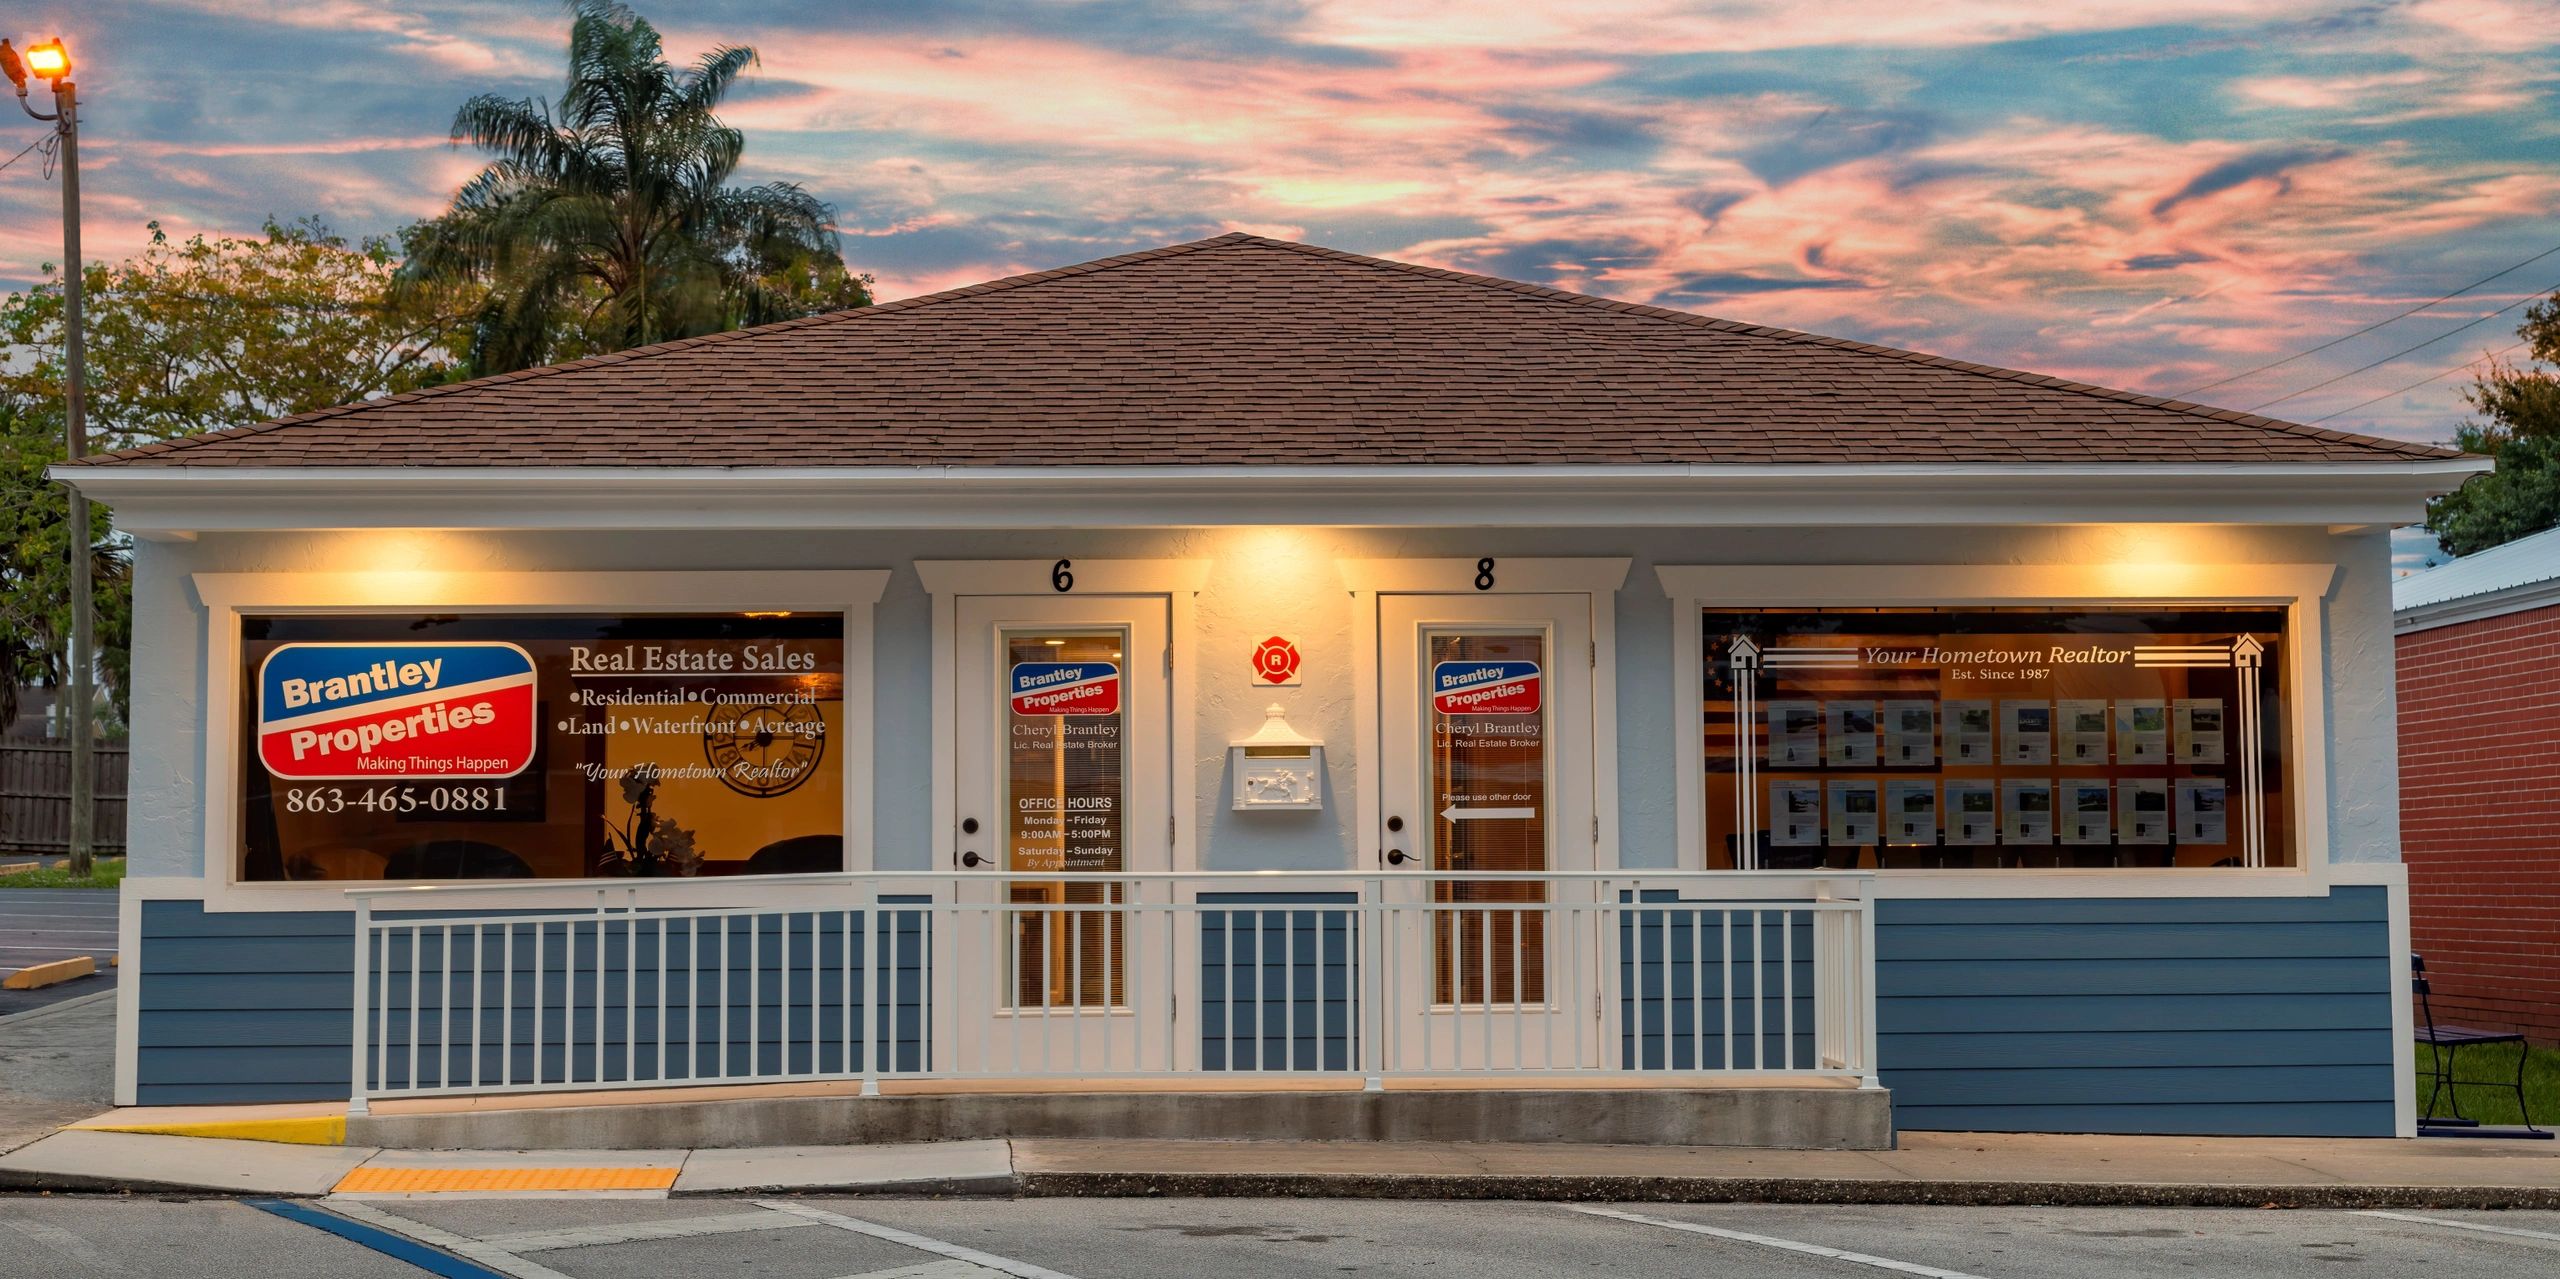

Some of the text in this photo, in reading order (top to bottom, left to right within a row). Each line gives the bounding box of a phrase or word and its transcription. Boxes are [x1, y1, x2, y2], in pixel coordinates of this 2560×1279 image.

[1052, 559, 1074, 593] 6
[1474, 557, 1496, 591] 8
[570, 645, 816, 672] Real Estate Sales
[1271, 654, 1282, 666] R
[1864, 646, 2131, 664] Your Hometown Realtor
[281, 658, 443, 709] Brantley
[1019, 667, 1083, 689] Brantley
[1441, 666, 1505, 688] Brantley
[1951, 669, 2050, 680] Est. Since 1987
[1023, 684, 1104, 709] Properties
[1445, 684, 1526, 708] Properties
[1088, 706, 1110, 714] Happen
[290, 701, 496, 761] Properties
[751, 716, 826, 740] Acreage
[1012, 724, 1119, 738] Cheryl Brantley
[1435, 722, 1541, 736] Cheryl Brantley
[1013, 741, 1030, 749] Lic.
[1032, 741, 1054, 749] Real
[1087, 741, 1118, 749] Broker
[1436, 739, 1540, 748] Lic. Real Estate Broker
[356, 756, 509, 773] Making Things Happen
[633, 762, 727, 781] Hometown
[286, 785, 508, 813] 863-465-0881
[1019, 797, 1113, 809] OFFICE HOURS
[1442, 793, 1471, 801] Please
[1489, 793, 1511, 801] other
[1512, 793, 1532, 801] door
[1027, 858, 1105, 869] By Appointment
